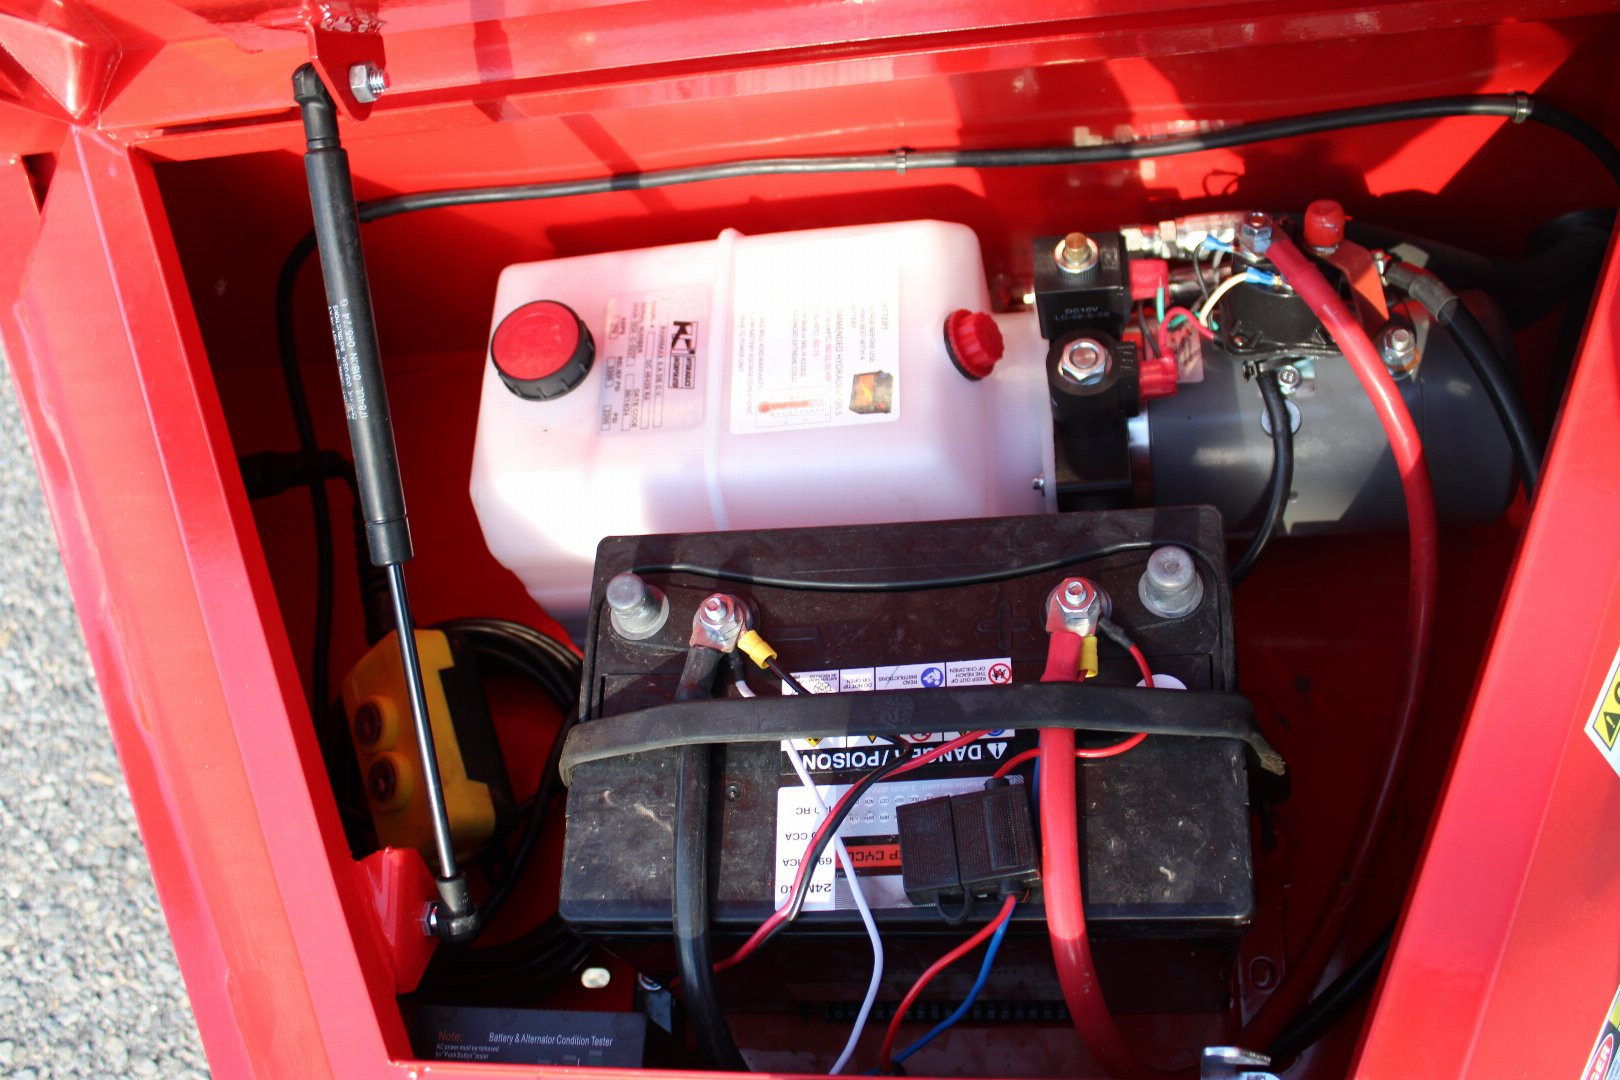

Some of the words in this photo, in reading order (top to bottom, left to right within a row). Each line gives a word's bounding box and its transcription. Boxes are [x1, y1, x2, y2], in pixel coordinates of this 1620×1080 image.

[333, 304, 346, 352] INSTRUCTIONS
[802, 750, 880, 769] POISON
[796, 807, 810, 815] RC
[845, 851, 884, 861] CYCL
[438, 1031, 463, 1042] Note:
[489, 1032, 514, 1044] Battery
[515, 1033, 520, 1043] &
[520, 1033, 555, 1045] Alternator
[556, 1035, 589, 1046] Condition
[591, 1037, 613, 1047] Tester
